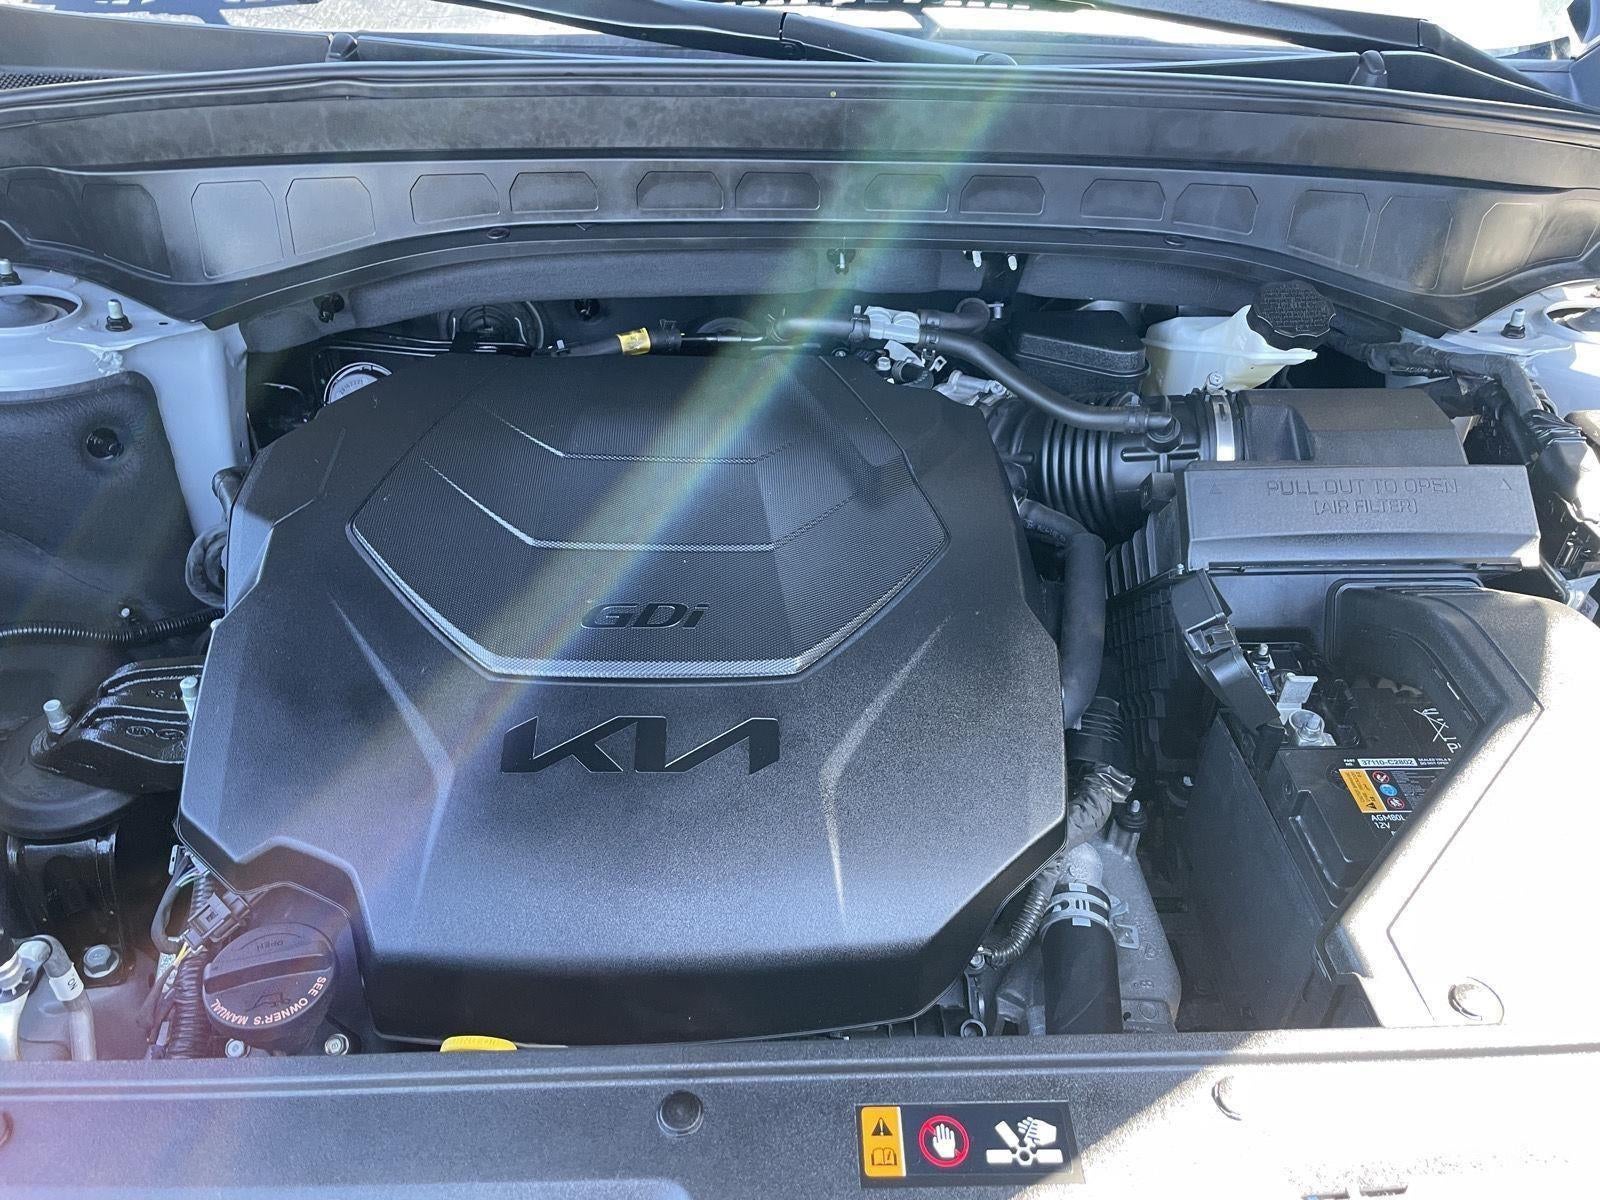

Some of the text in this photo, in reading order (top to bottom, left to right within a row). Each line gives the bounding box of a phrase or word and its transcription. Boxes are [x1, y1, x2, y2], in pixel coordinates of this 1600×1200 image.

[1266, 478, 1458, 496] PULL OUT TO OPEN
[580, 602, 709, 629] GDi
[501, 715, 781, 775] KIA
[211, 976, 327, 1026] SEE OWNER'S MANUAL
